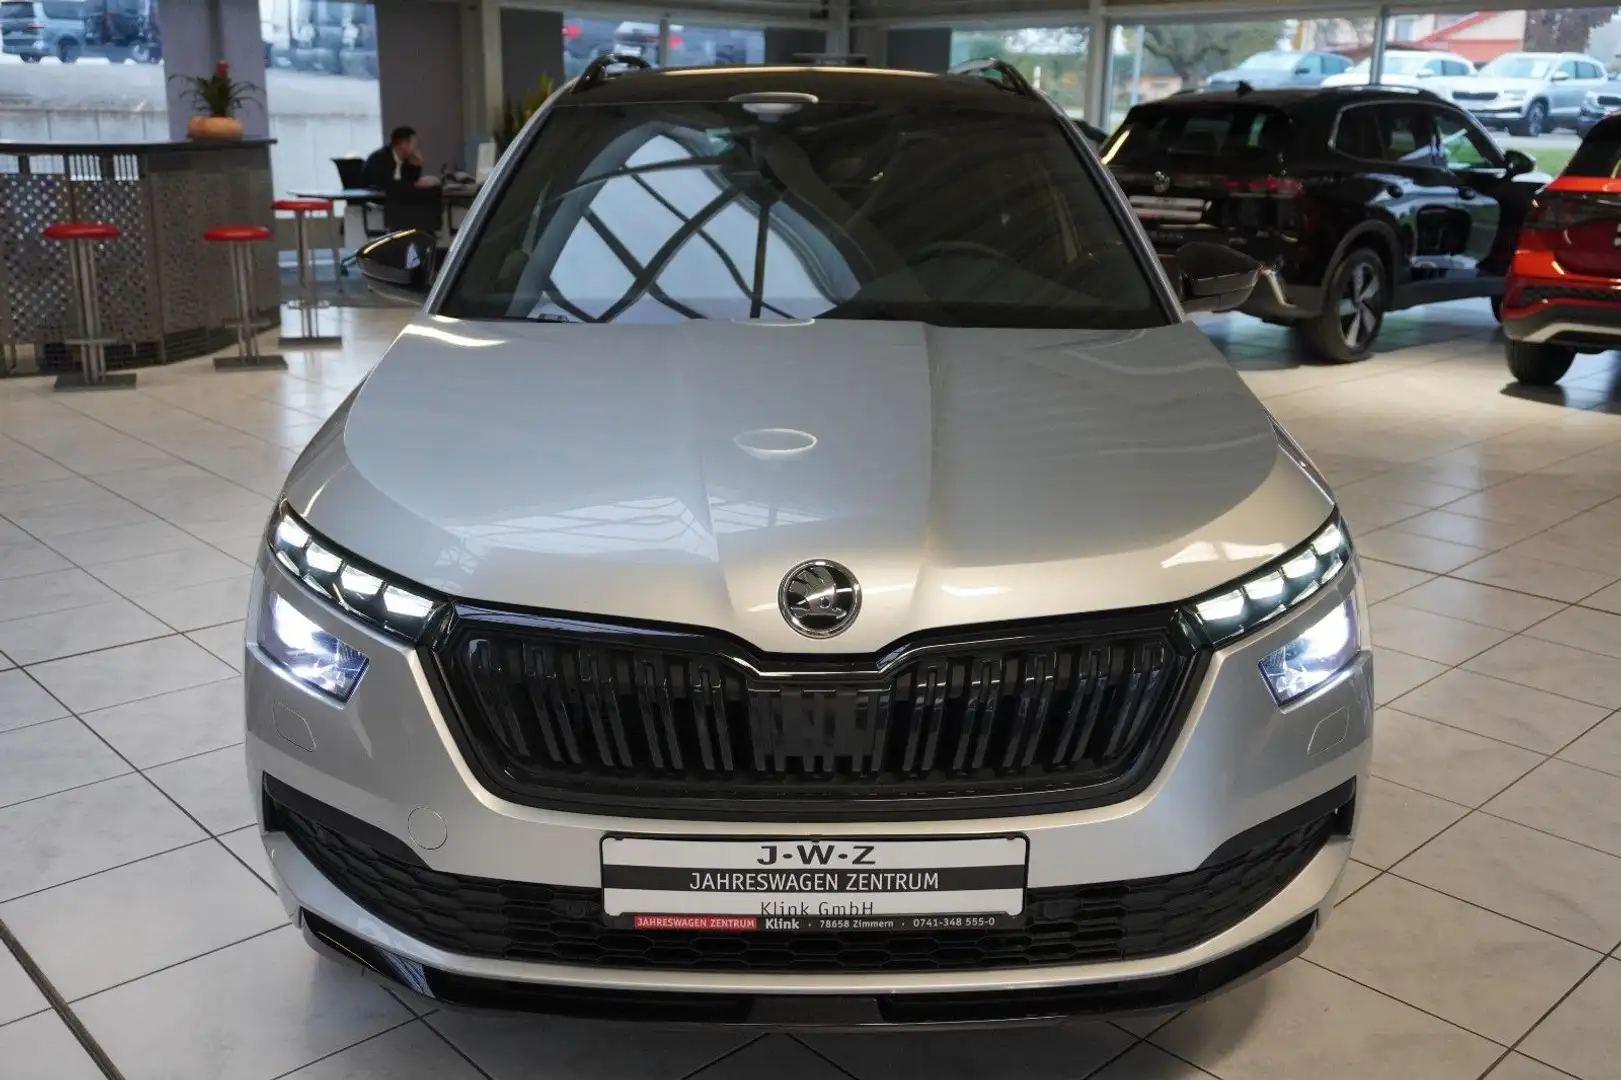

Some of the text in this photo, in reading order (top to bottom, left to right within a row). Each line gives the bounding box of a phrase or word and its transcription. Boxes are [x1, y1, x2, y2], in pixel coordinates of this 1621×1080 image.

[689, 872, 939, 891] JAHRESWAGEN ZENTRUM
[760, 901, 873, 915] Klink GmbH
[637, 917, 996, 930] JAHRESWAGEN ZENTRUM Klink 78658 Zimmern 0741-348 555-0
